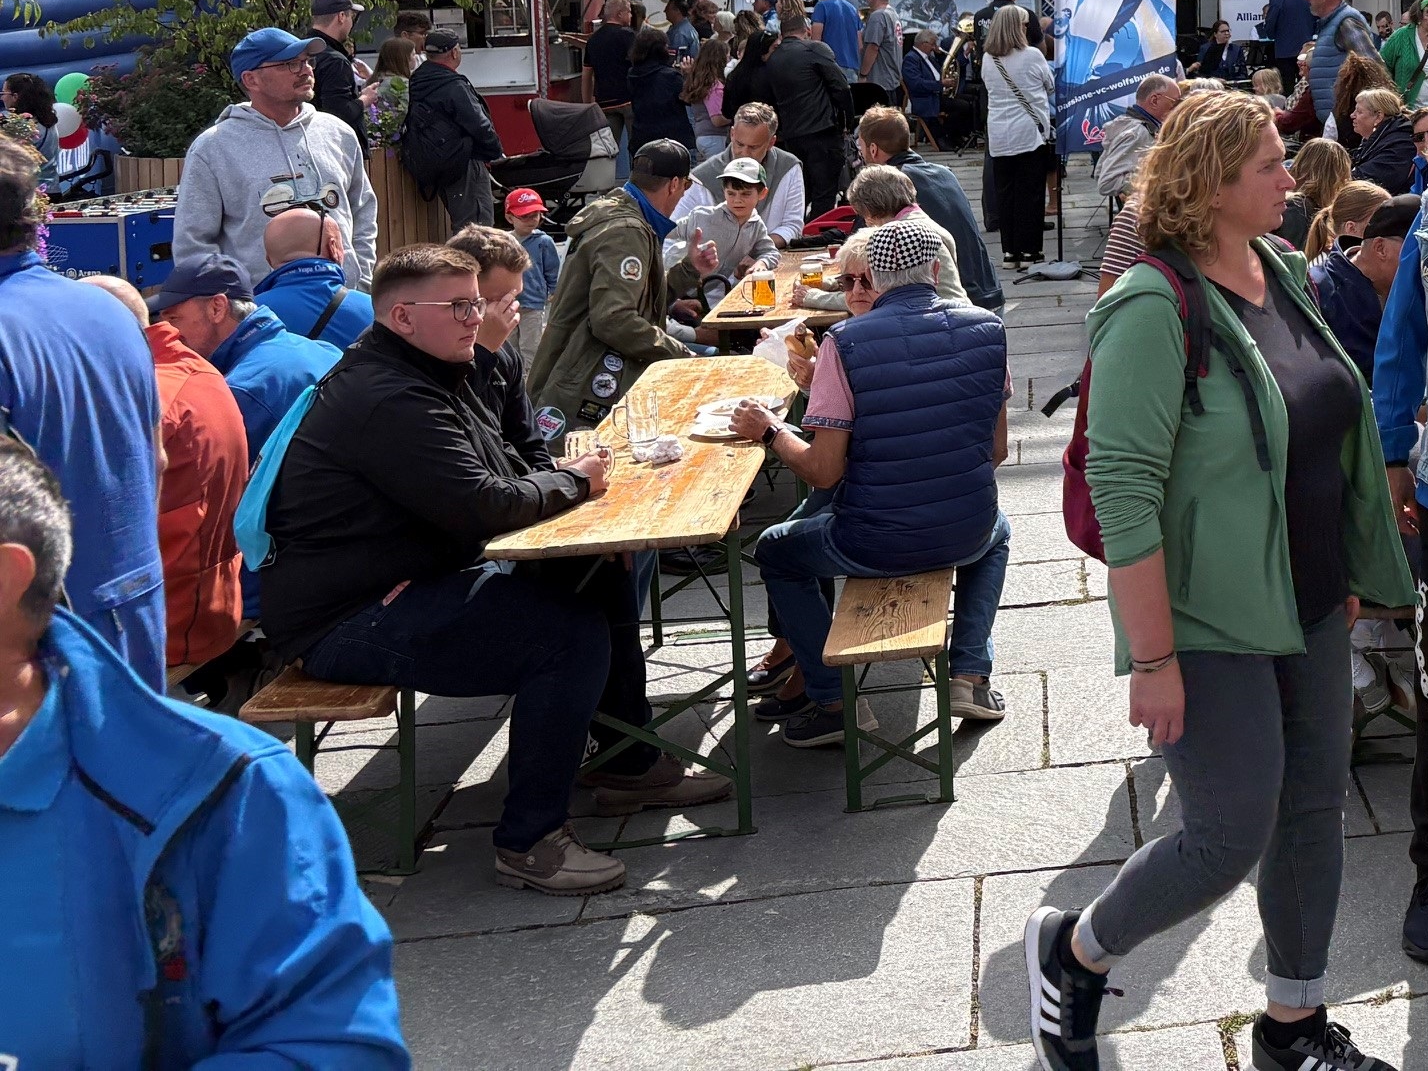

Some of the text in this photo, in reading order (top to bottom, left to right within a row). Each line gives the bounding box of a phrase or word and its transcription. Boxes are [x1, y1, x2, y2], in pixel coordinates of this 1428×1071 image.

[1236, 12, 1264, 21] Allian
[1057, 65, 1171, 113] passione-vc-wolfsburde
[314, 264, 327, 272] Club
